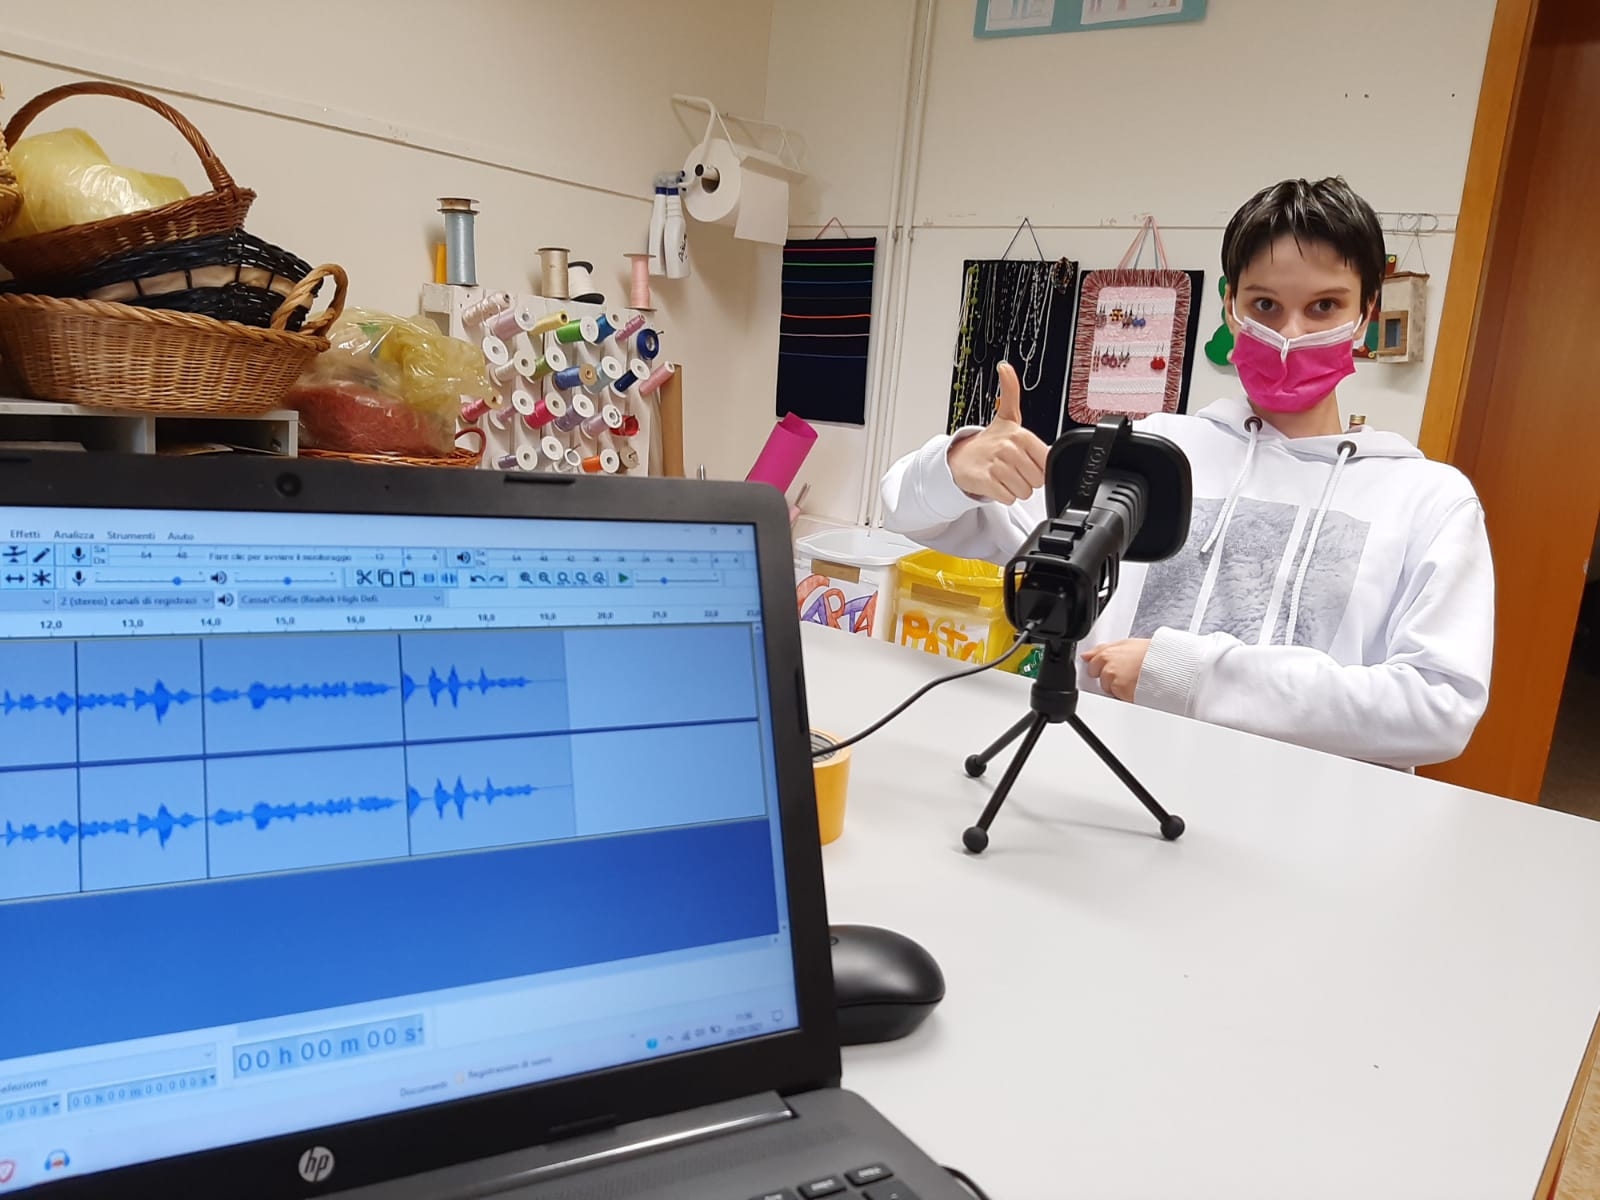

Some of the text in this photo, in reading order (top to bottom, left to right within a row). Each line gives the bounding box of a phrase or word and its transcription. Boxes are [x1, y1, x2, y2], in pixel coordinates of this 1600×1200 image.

[10, 529, 41, 540] Effetti
[53, 530, 95, 541] Analizza
[106, 531, 156, 541] Strumenti
[167, 532, 195, 542] Aiuto
[40, 619, 63, 631] 12,0
[122, 618, 145, 629] 13,0
[200, 617, 222, 628] 14,0
[275, 616, 296, 627] 15,0
[346, 614, 366, 625] 16,0
[413, 613, 433, 624] 17,0
[301, 1147, 332, 1182] hp
